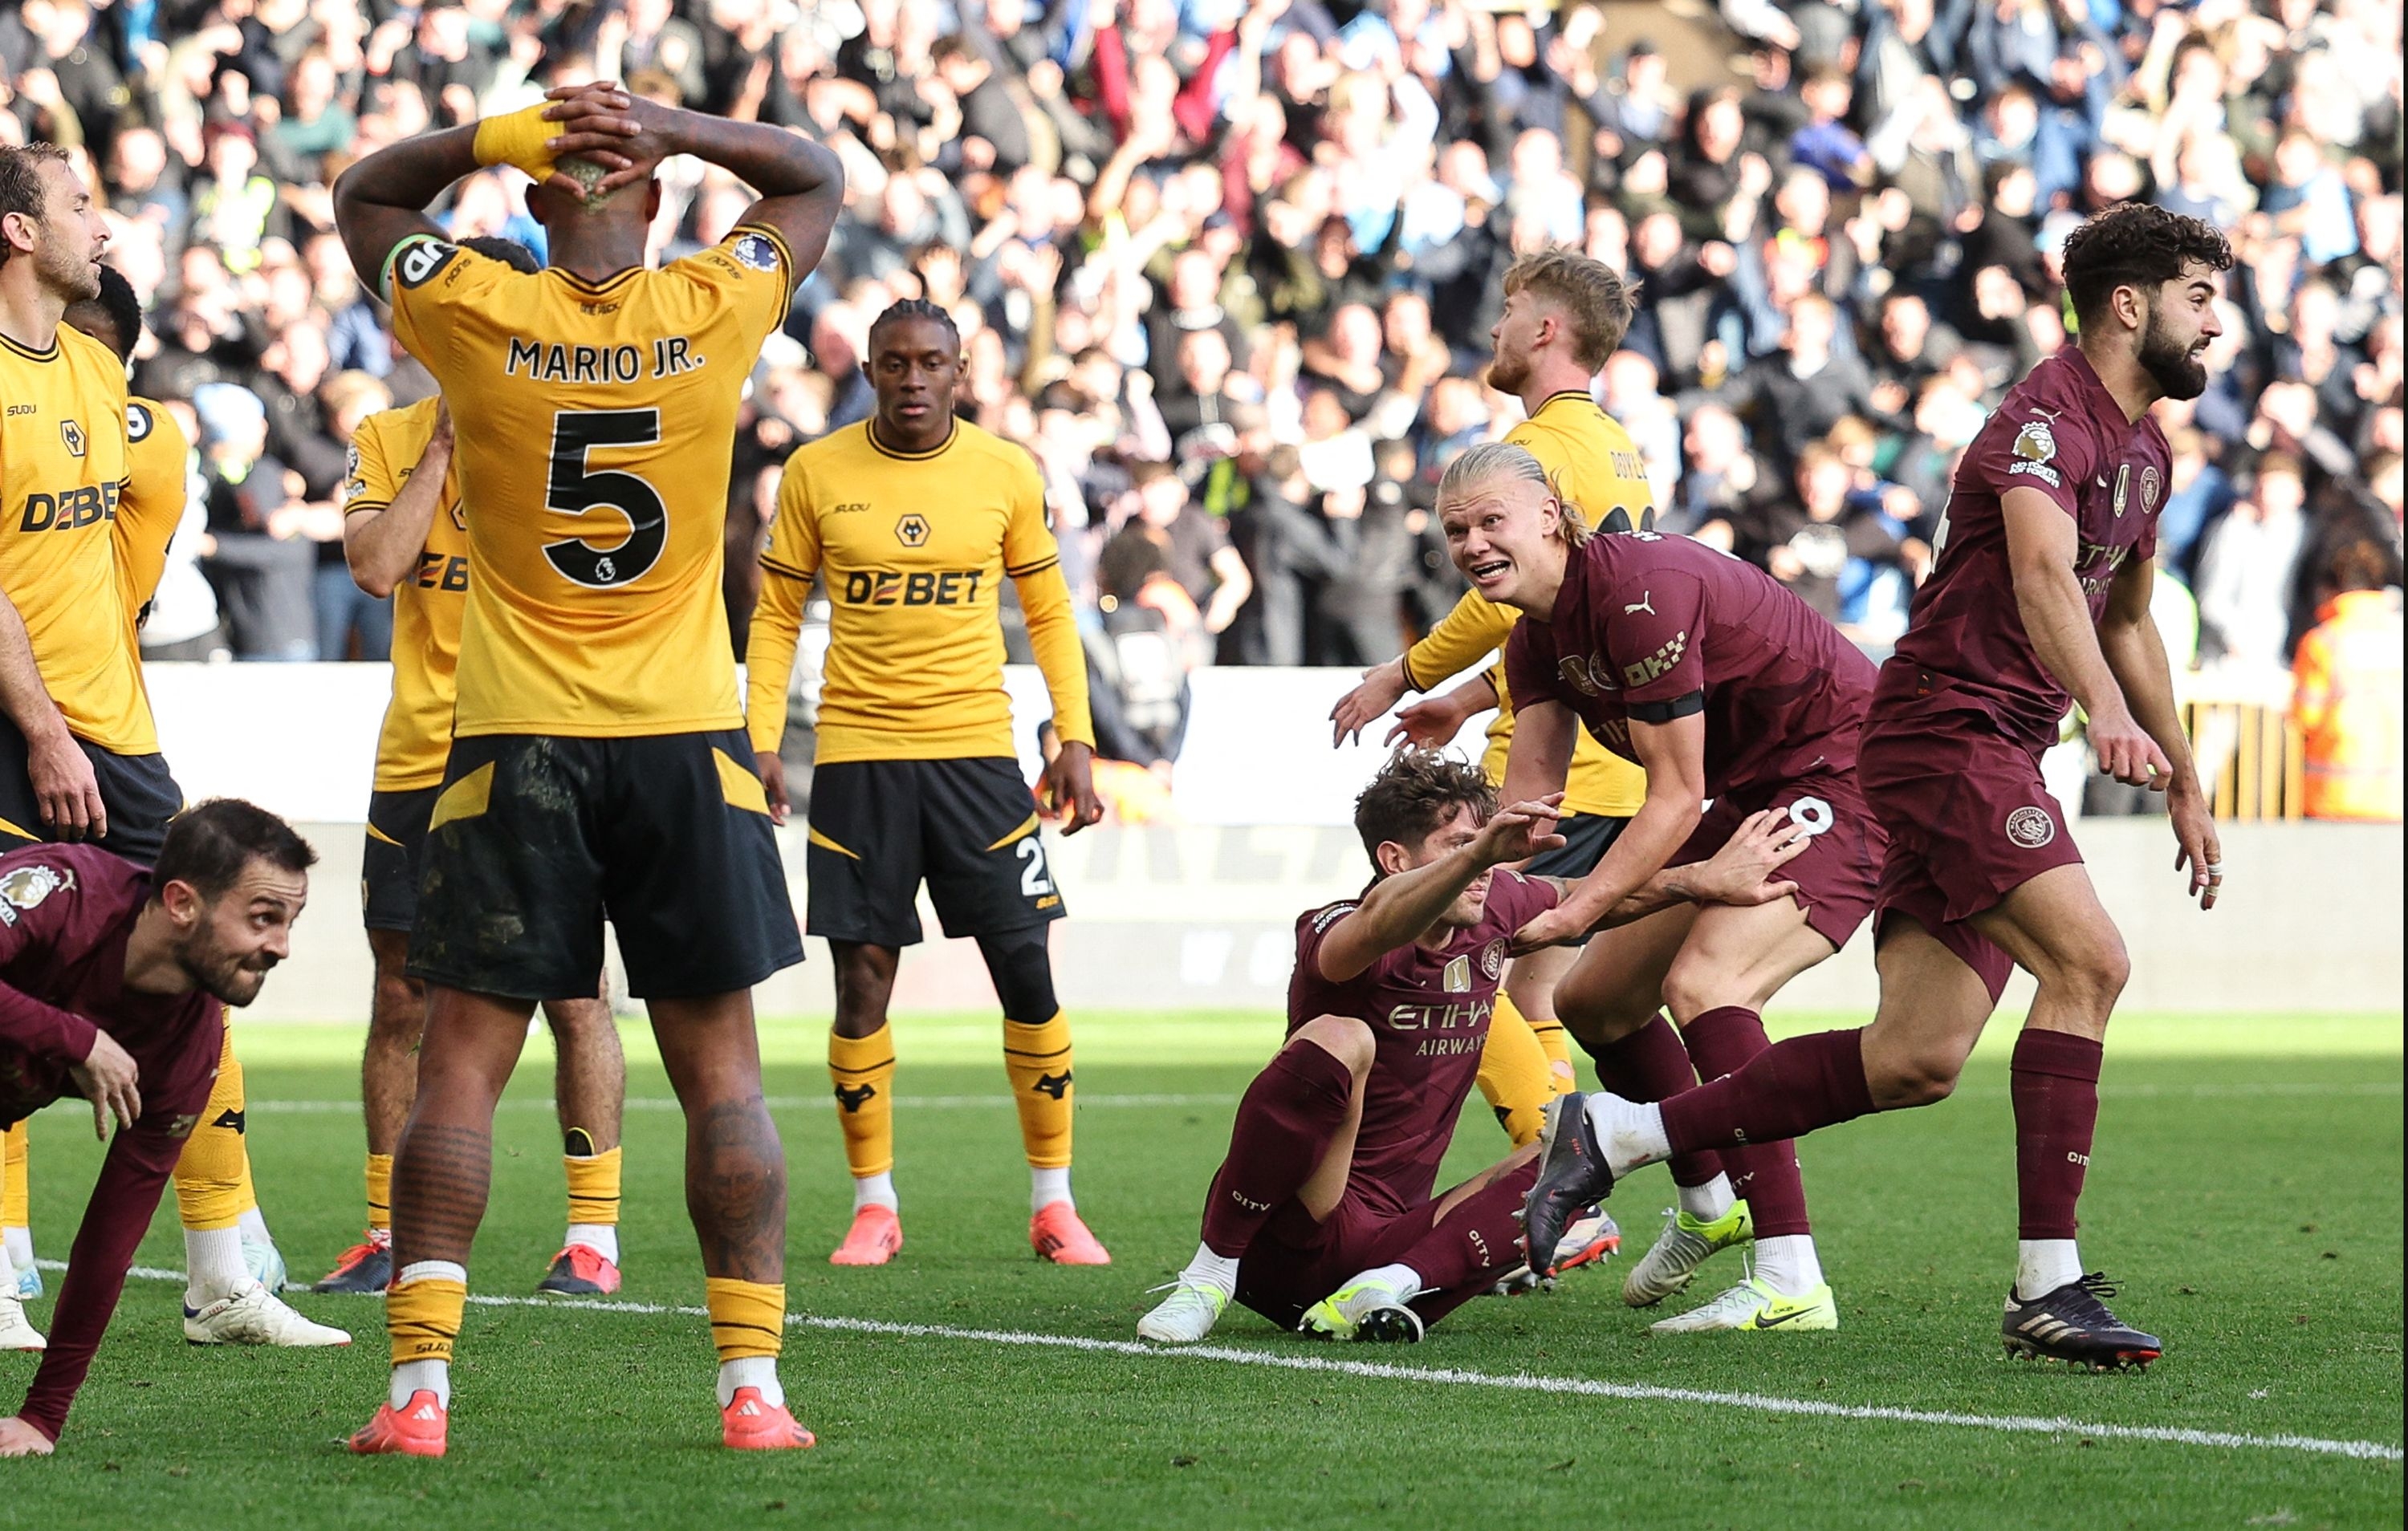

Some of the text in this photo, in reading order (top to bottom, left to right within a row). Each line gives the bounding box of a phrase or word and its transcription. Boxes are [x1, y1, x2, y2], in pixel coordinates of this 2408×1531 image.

[505, 335, 708, 385] MARIO JR.
[19, 481, 122, 533] DEBE
[540, 406, 669, 590] 5
[845, 569, 984, 607] DEBET
[1016, 835, 1055, 896] 2
[1388, 999, 1495, 1030] ETIHA
[2067, 1151, 2090, 1167] CIT
[1731, 1171, 1755, 1190] ITY
[1232, 1190, 1271, 1212] CITY
[1468, 1229, 1491, 1268] CITY
[414, 1342, 451, 1354] SUD
